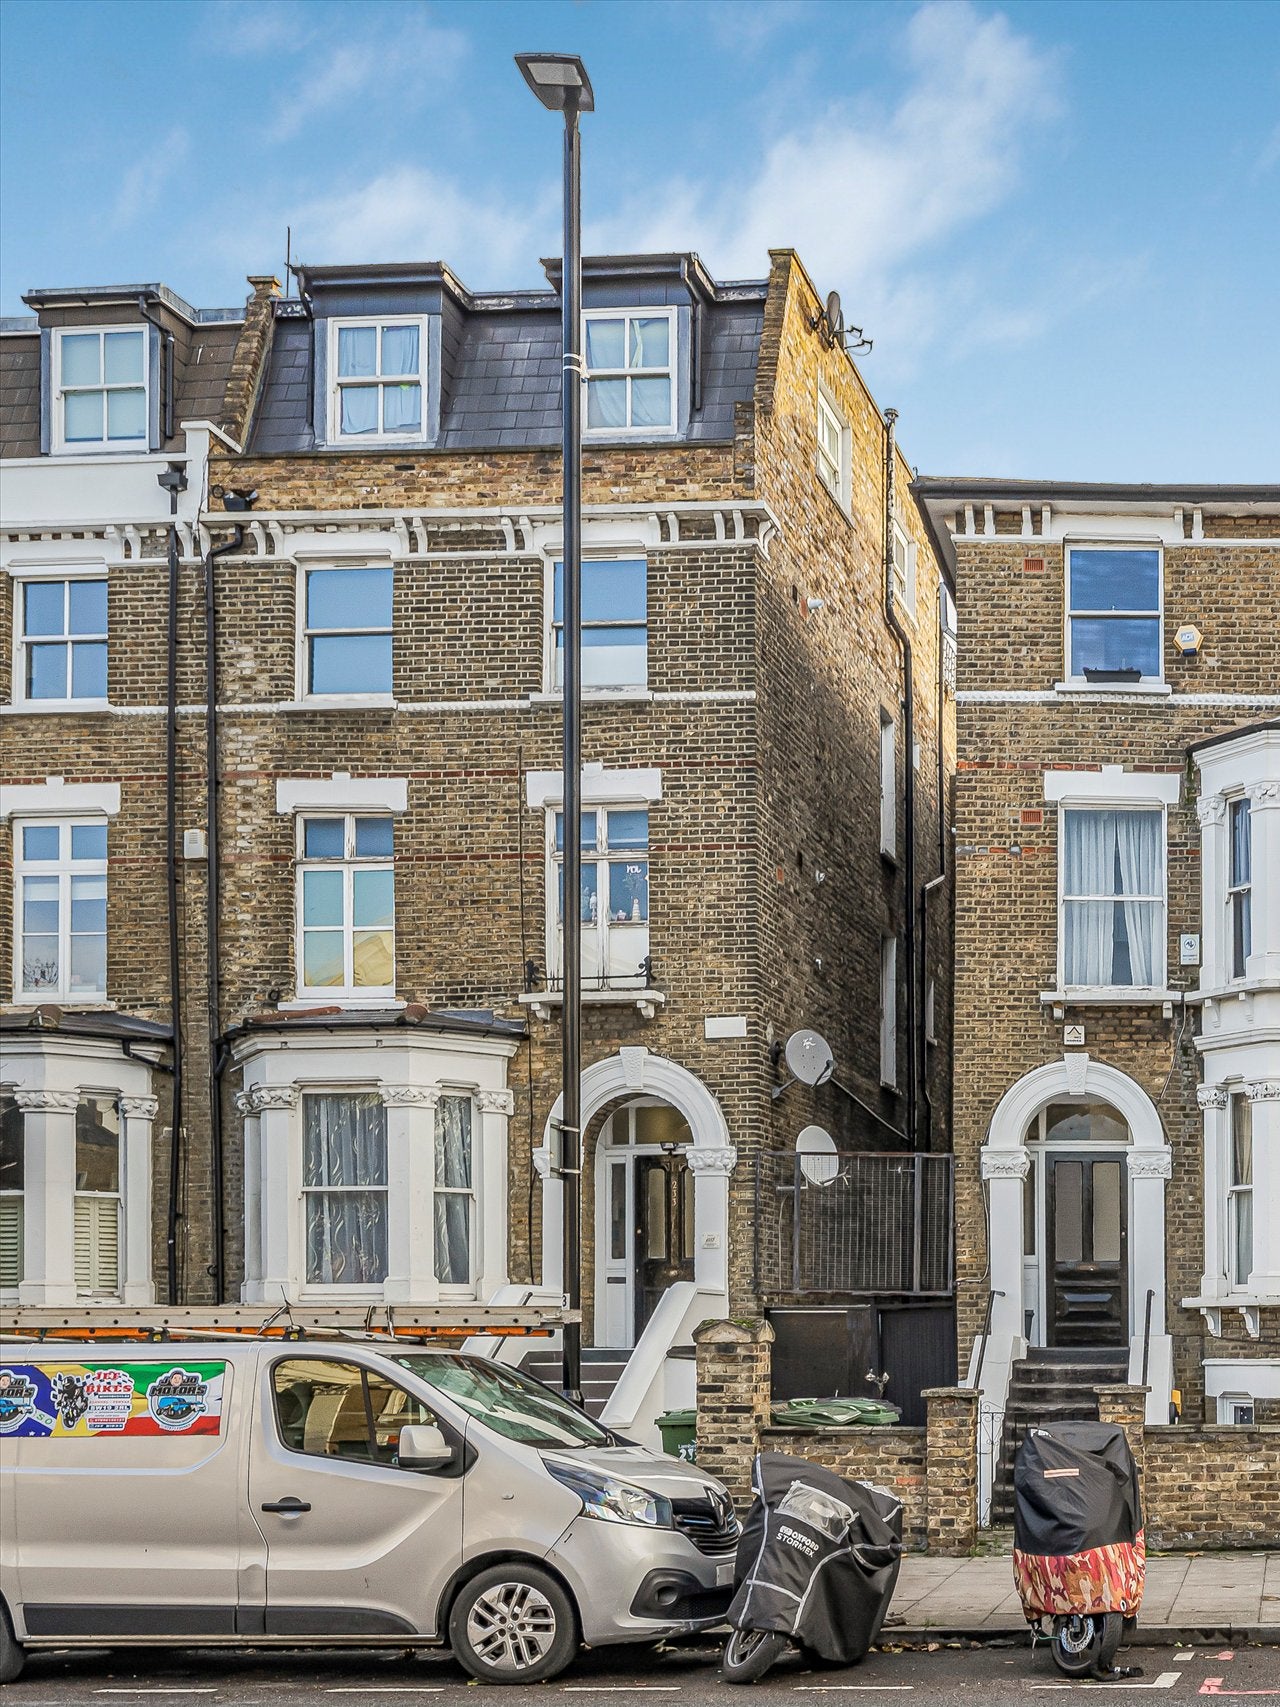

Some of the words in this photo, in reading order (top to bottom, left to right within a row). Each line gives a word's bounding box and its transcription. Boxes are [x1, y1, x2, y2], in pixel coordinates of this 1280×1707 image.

[86, 1383, 133, 1394] BIKES
[149, 1385, 208, 1397] MOTORS
[776, 1532, 815, 1558] STORMEX
[791, 1531, 820, 1551] OXFORD
